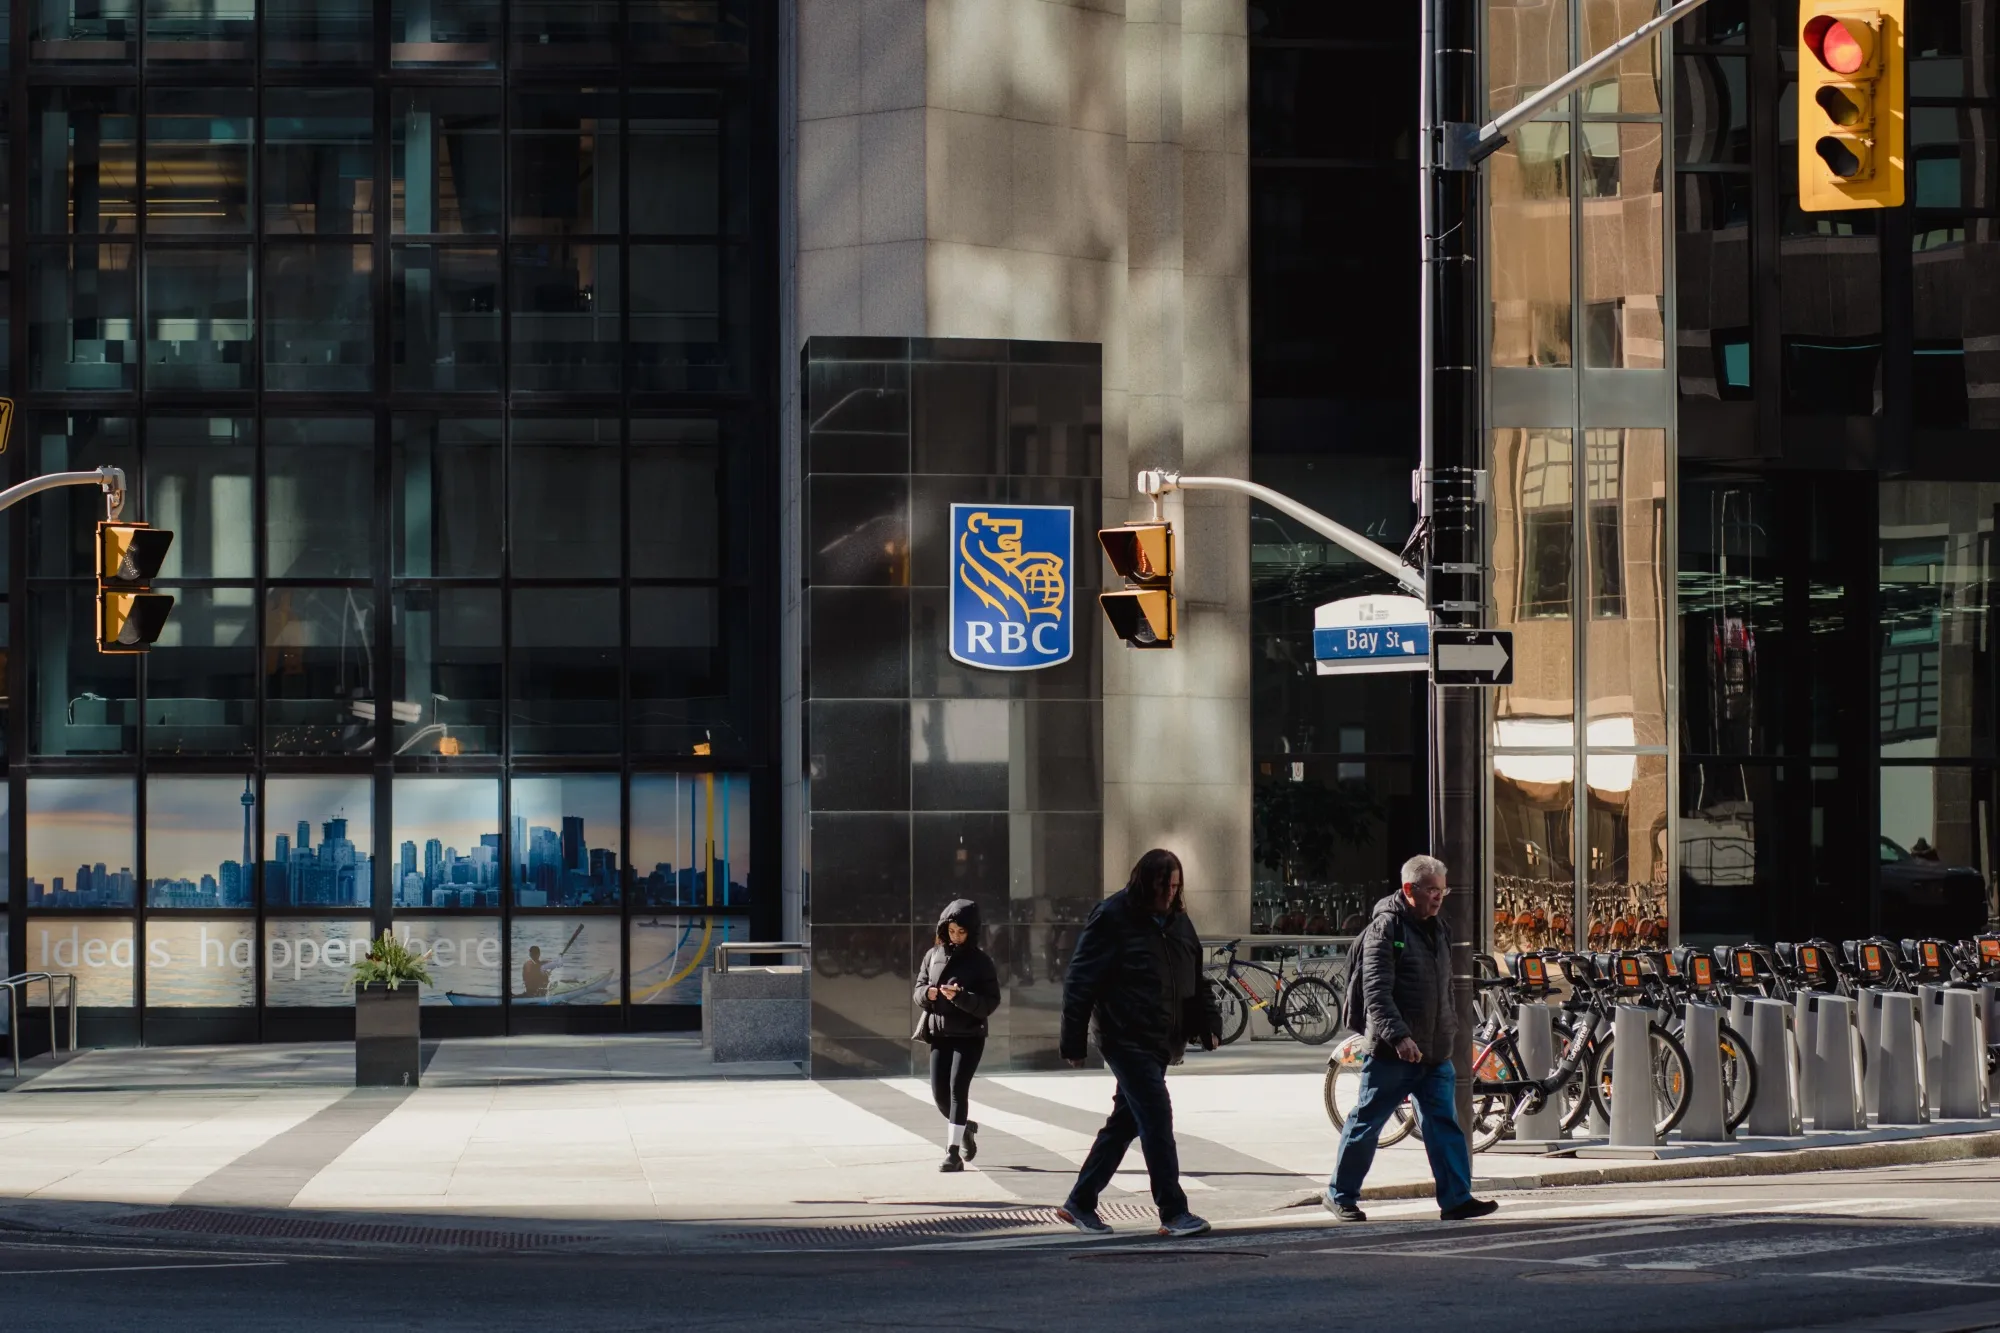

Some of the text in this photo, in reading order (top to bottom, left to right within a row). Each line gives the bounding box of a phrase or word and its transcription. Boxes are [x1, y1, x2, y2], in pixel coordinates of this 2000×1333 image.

[965, 620, 1059, 654] RBC
[1347, 629, 1400, 654] Bay St
[39, 925, 171, 968] Ideas
[403, 925, 500, 967] here
[1566, 1025, 1588, 1062] Tangerine
